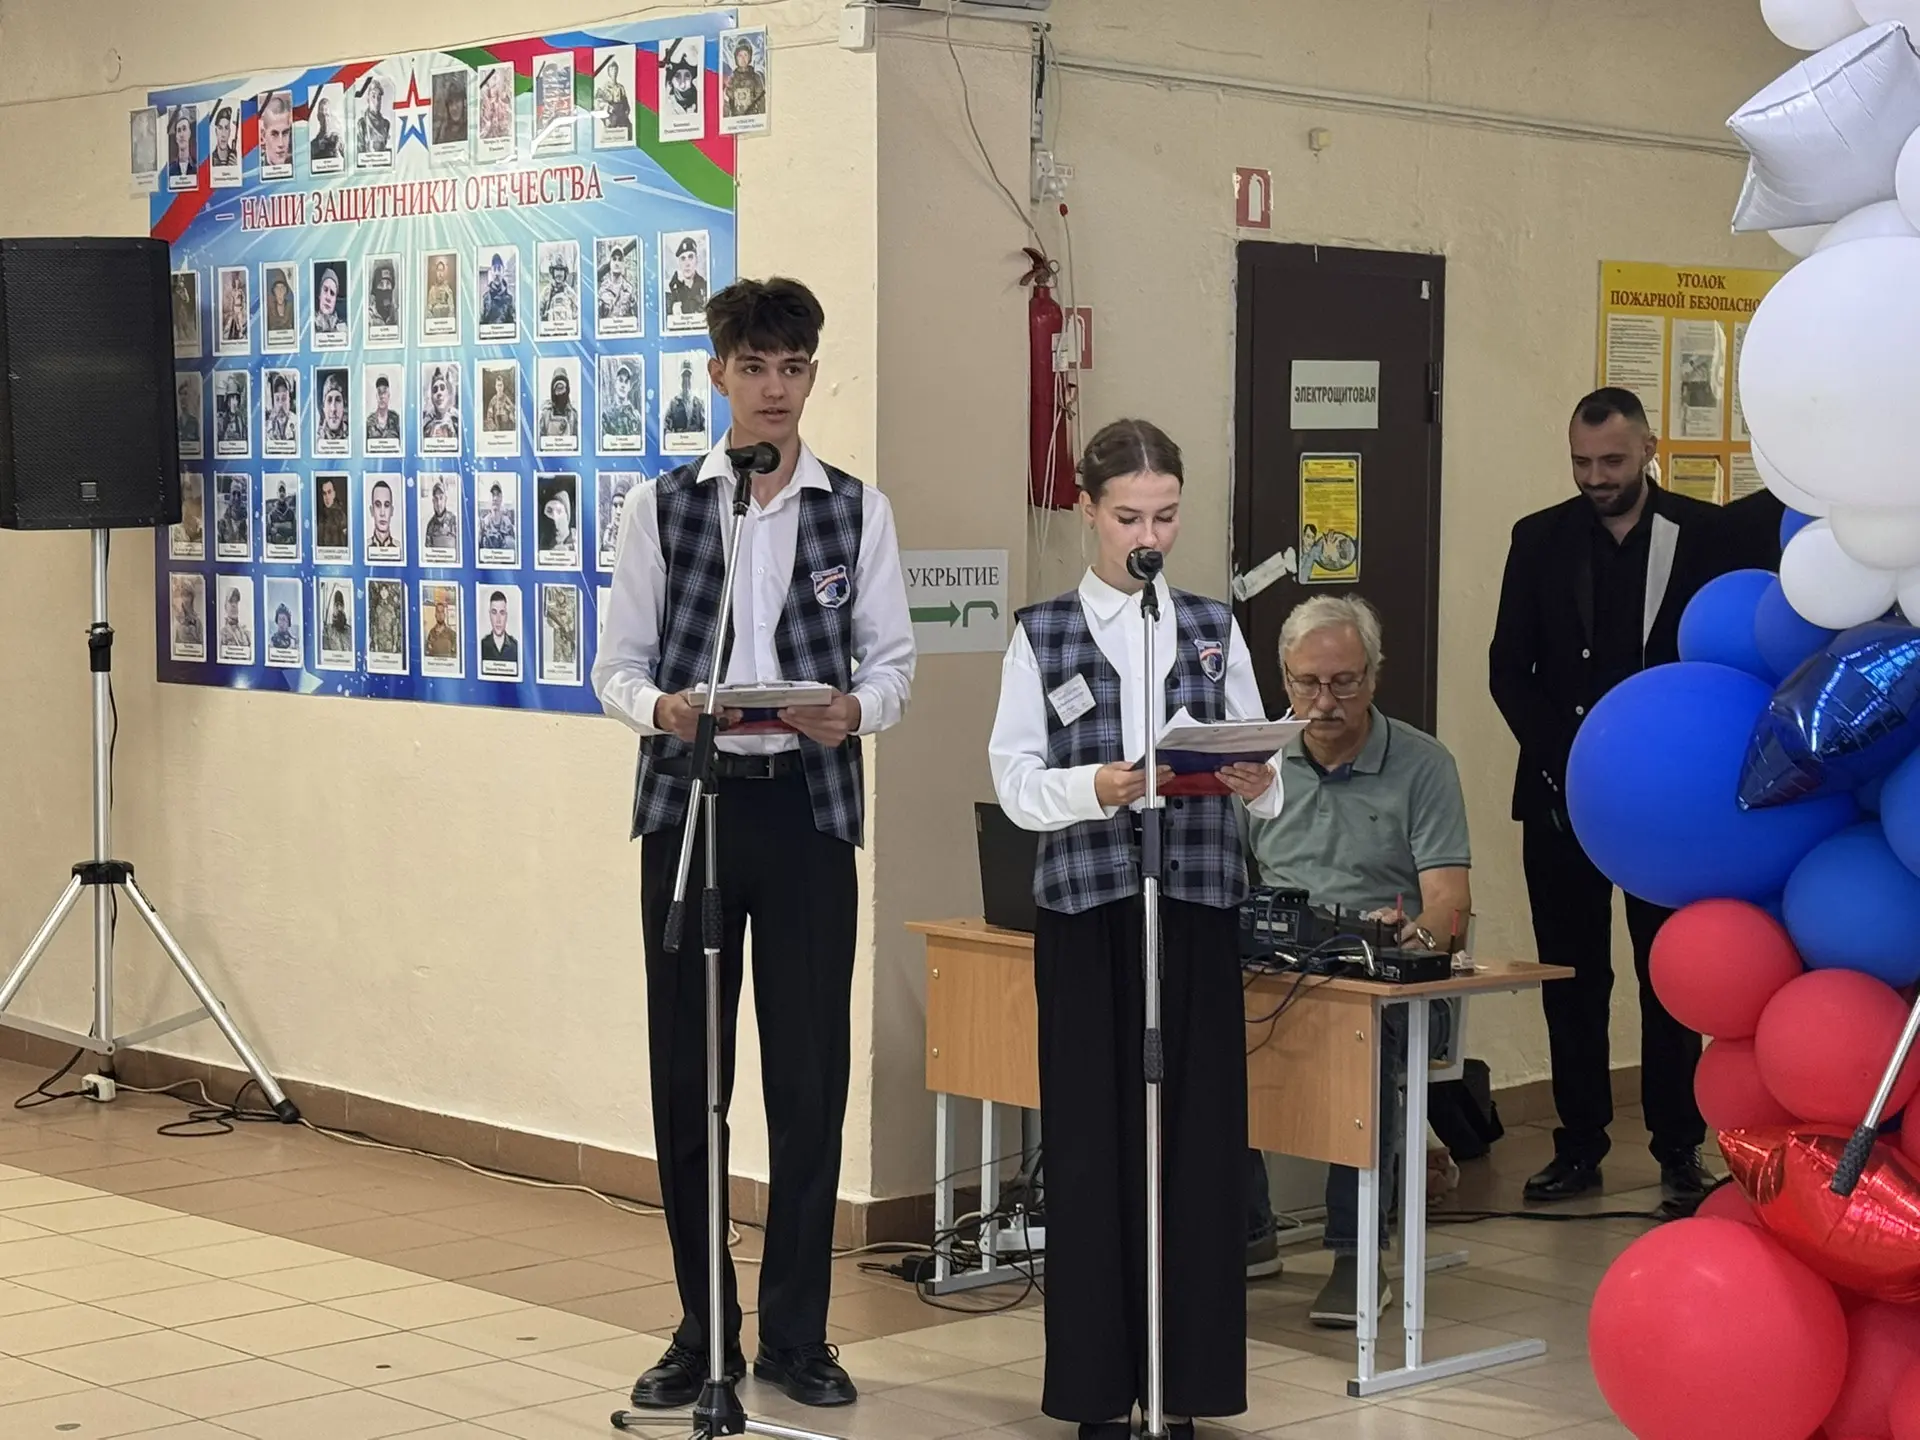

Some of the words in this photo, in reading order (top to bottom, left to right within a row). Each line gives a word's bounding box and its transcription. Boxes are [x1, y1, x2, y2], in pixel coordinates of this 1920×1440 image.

[242, 193, 305, 230] НАШИ
[312, 178, 457, 227] ЗАЩИТНИКИ
[465, 163, 603, 210] ОТЕЧЕСТВА
[1677, 272, 1726, 290] УГОЛОК
[1611, 291, 1685, 309] ПОЖАРНОЙ
[1294, 386, 1376, 406] ЭЛЕКТРОЩИТОВАЯ
[907, 566, 1000, 588] УКРЫТИЕ
